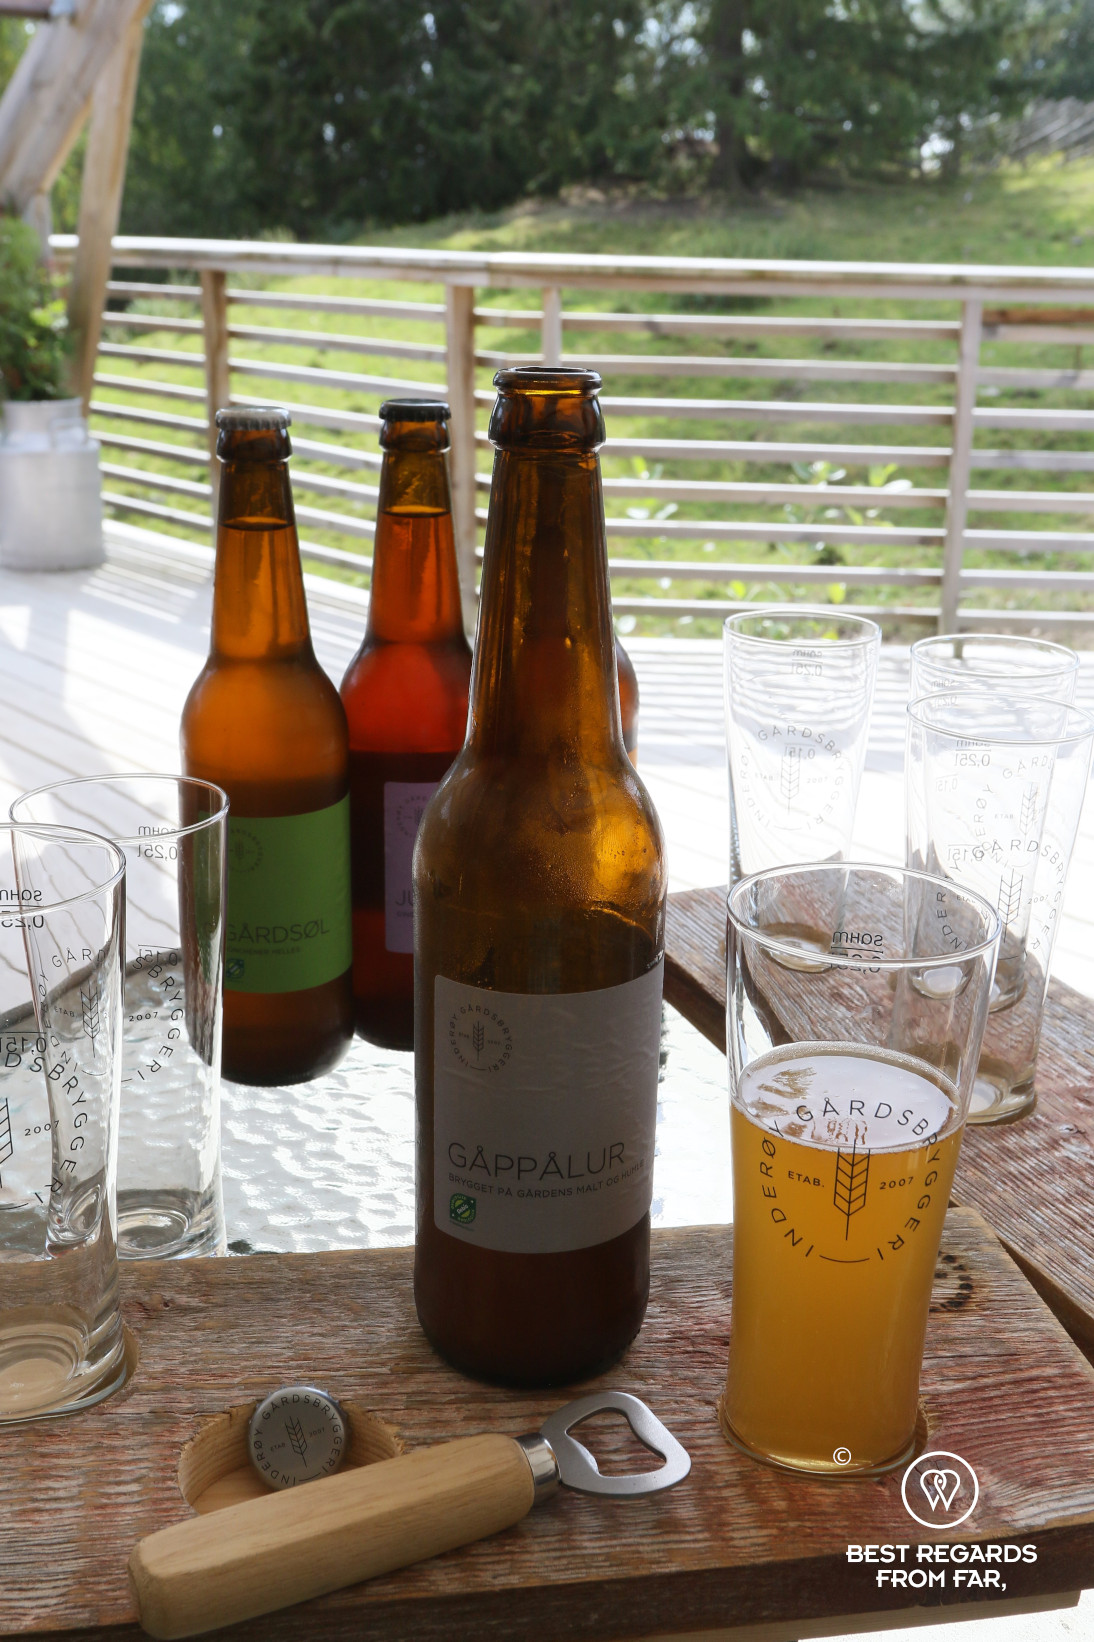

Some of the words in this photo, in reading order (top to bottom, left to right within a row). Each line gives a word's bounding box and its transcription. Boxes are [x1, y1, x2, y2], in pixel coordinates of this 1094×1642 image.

[3, 1051, 88, 1205] DSBRYGGERI
[24, 1119, 60, 1137] 2007
[447, 1141, 625, 1181] GÅPPÅLUR
[448, 1172, 494, 1194] BRYGGET
[498, 1185, 514, 1197] PÅ
[517, 1185, 573, 1199] GÅRDENS
[576, 1180, 604, 1195] MALT
[606, 1174, 620, 1186] OG
[621, 1158, 645, 1180] HUMLE
[760, 1120, 814, 1258] INDERØY
[796, 1096, 942, 1261] GÅRDSBRYGGERI
[787, 1170, 825, 1188] ETAB.
[879, 1176, 915, 1190] 2007
[253, 1428, 296, 1487] INDERØY
